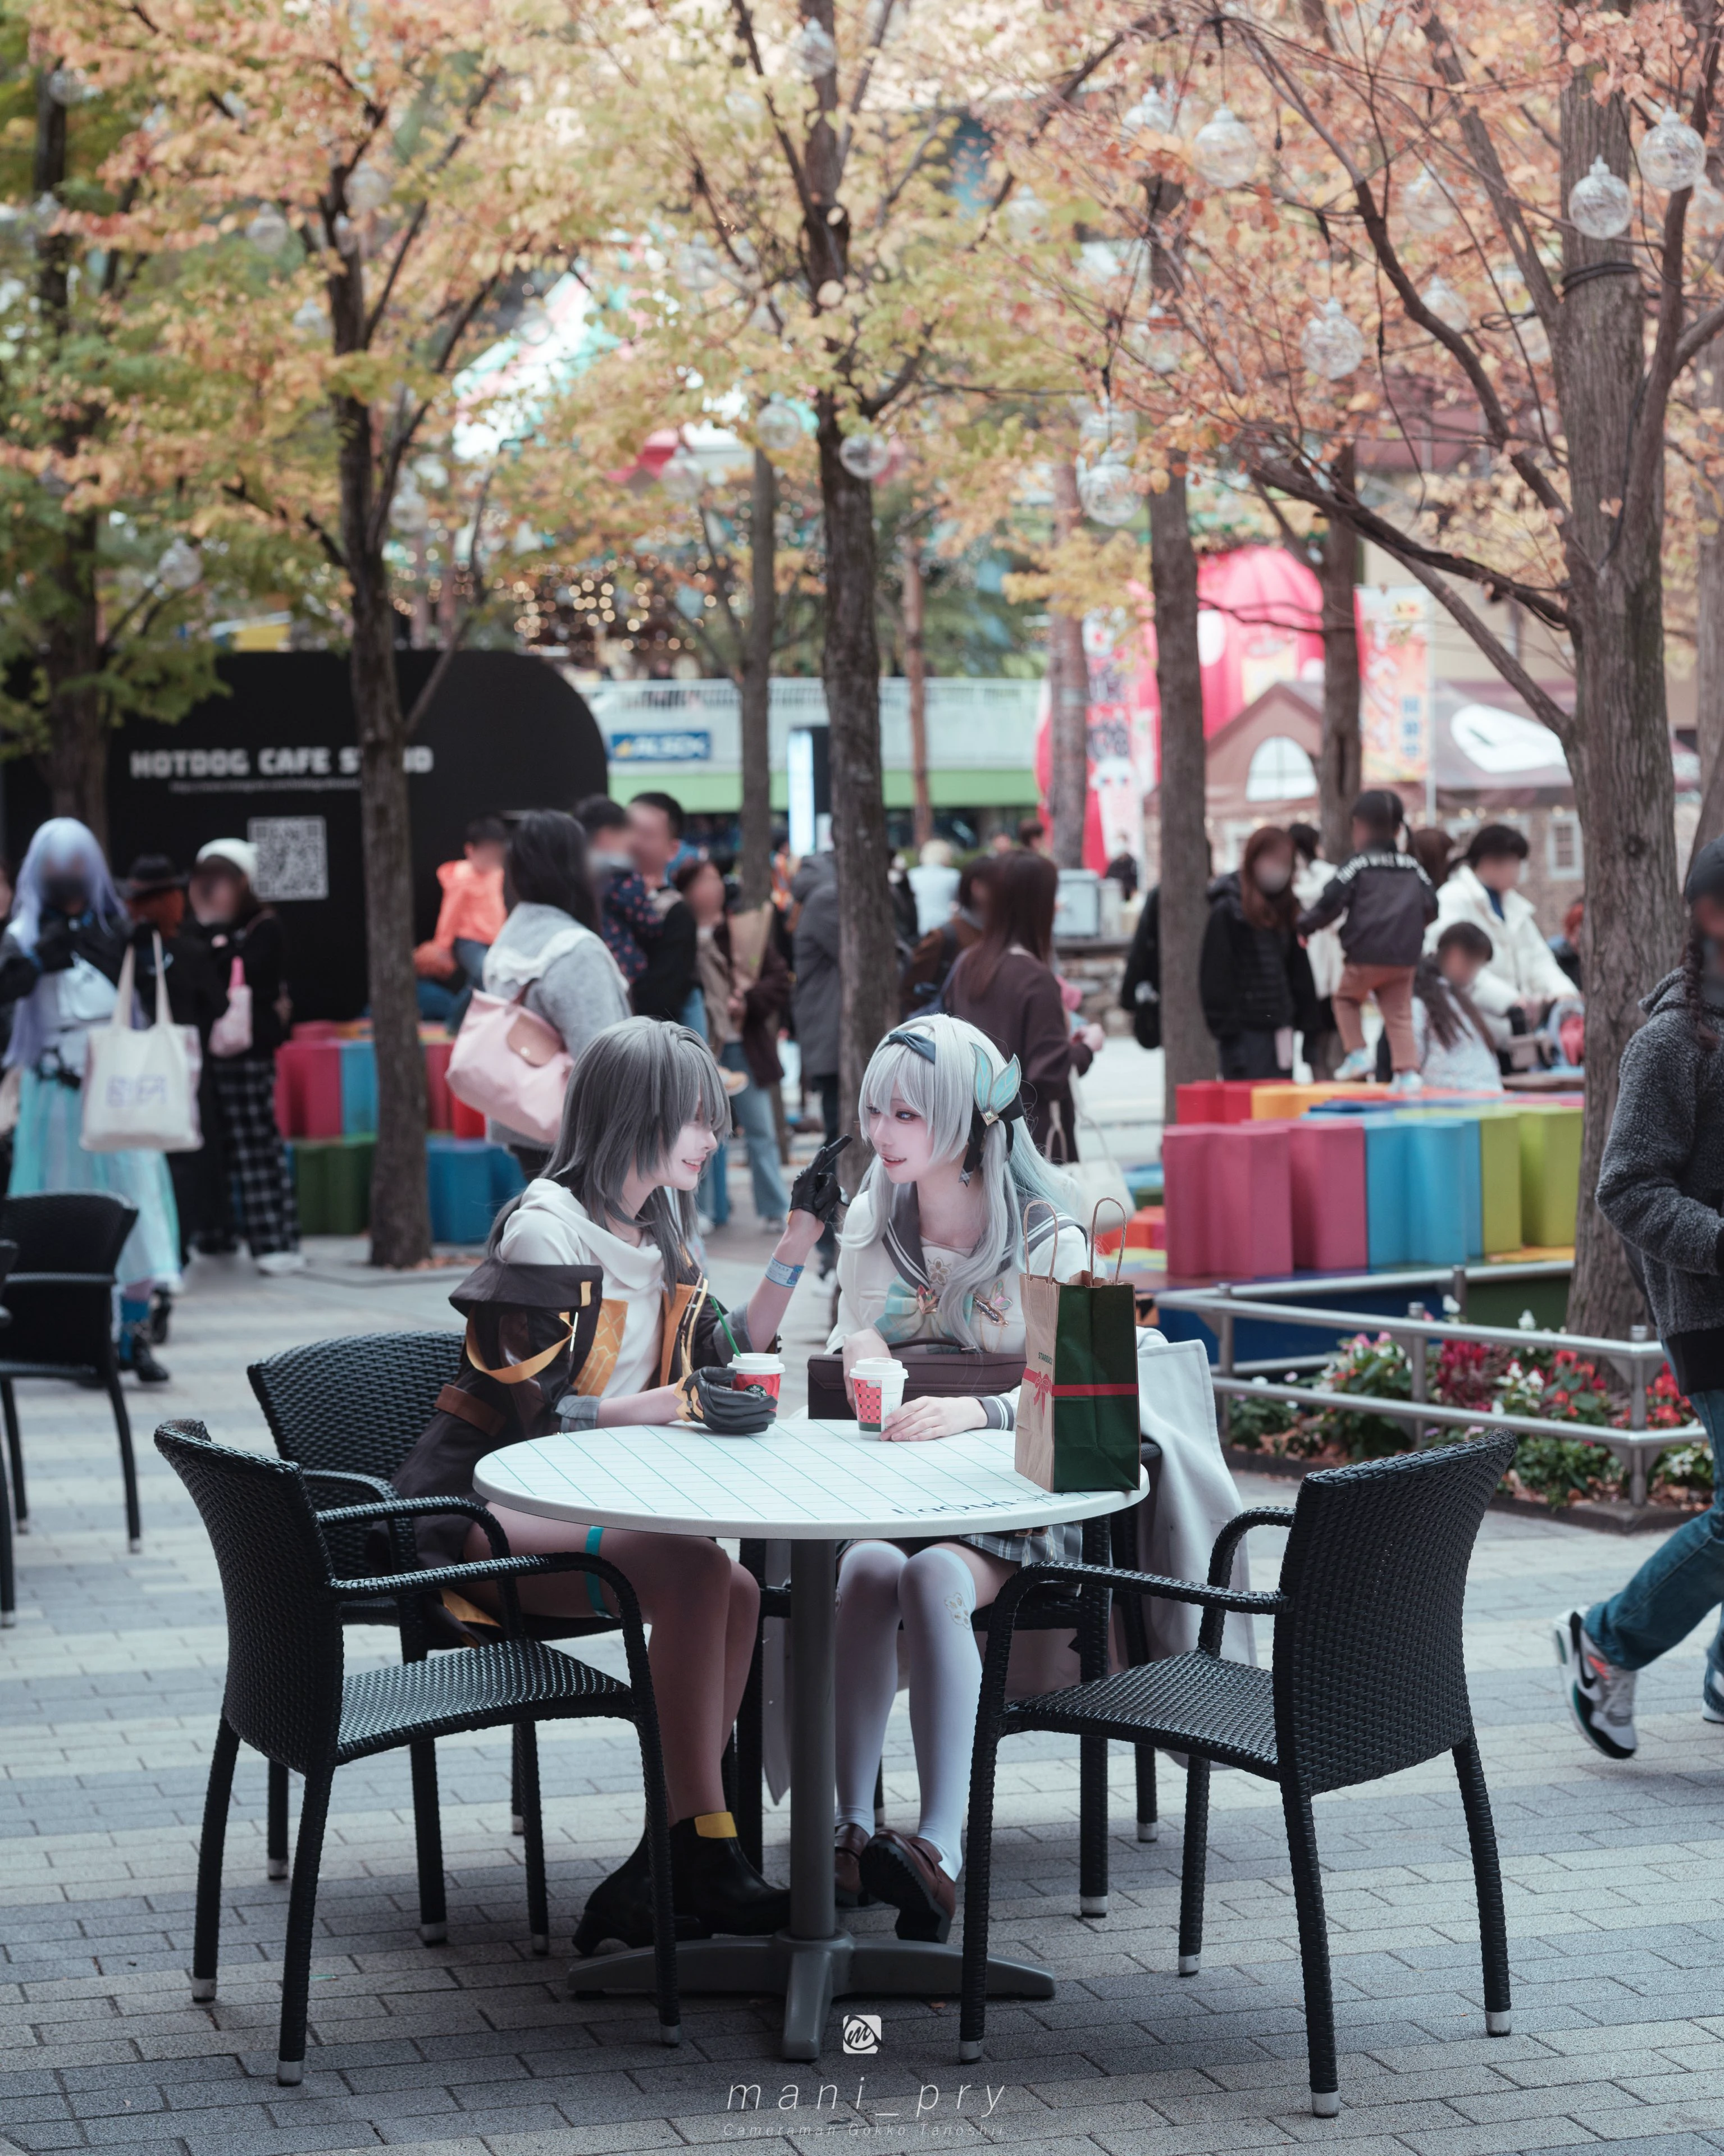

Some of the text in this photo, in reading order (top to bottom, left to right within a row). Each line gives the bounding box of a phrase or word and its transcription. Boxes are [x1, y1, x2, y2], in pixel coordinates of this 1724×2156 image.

[130, 749, 249, 778] HOTDOG
[258, 747, 330, 775] CAFE
[1016, 1492, 1072, 1502] SHO
